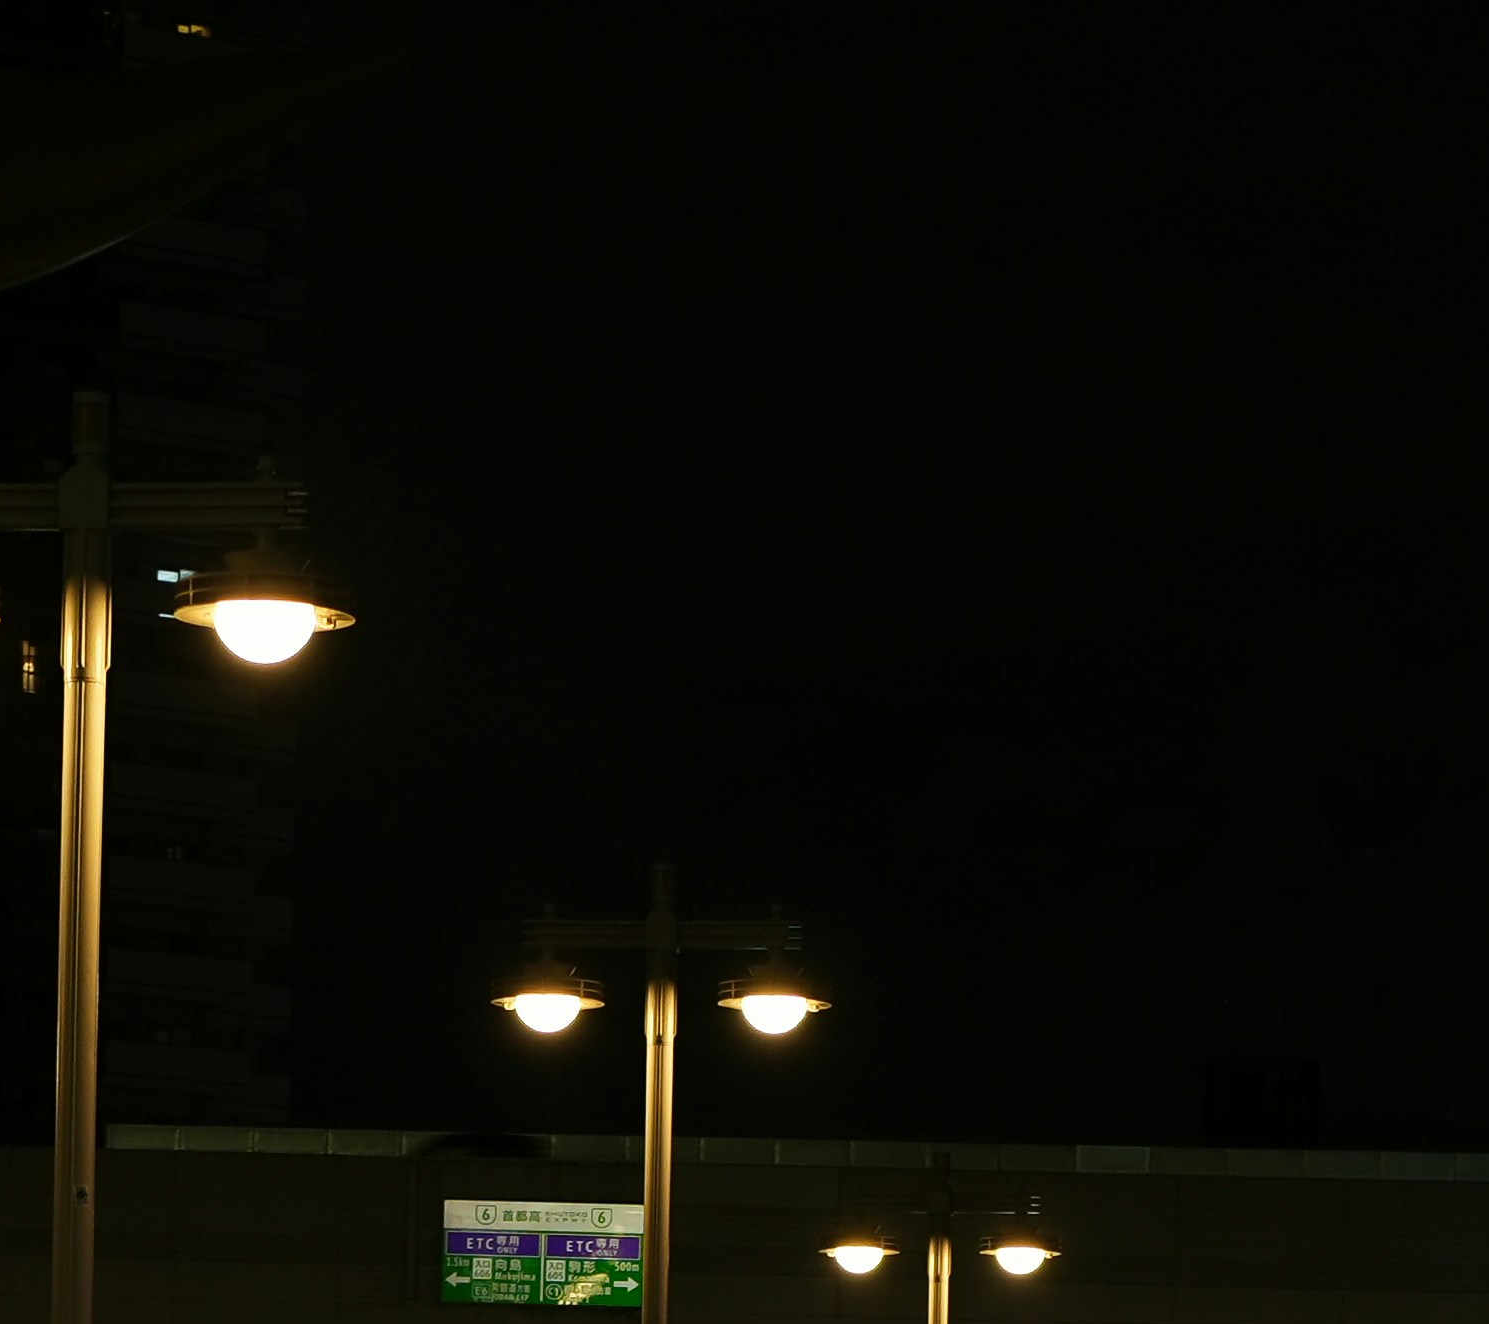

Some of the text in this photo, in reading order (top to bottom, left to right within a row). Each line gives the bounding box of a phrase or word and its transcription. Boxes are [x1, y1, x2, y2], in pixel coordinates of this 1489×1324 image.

[482, 1208, 490, 1221] 6
[502, 1209, 541, 1222] 首都高
[597, 1211, 606, 1224] 6
[466, 1237, 494, 1250] ETC
[565, 1240, 594, 1253] ETC
[496, 1246, 518, 1254] ONLY
[475, 1259, 490, 1268] 入口
[495, 1259, 522, 1271] 向島
[548, 1262, 564, 1270] 入口
[614, 1261, 640, 1272] 500m
[475, 1286, 488, 1296] E6
